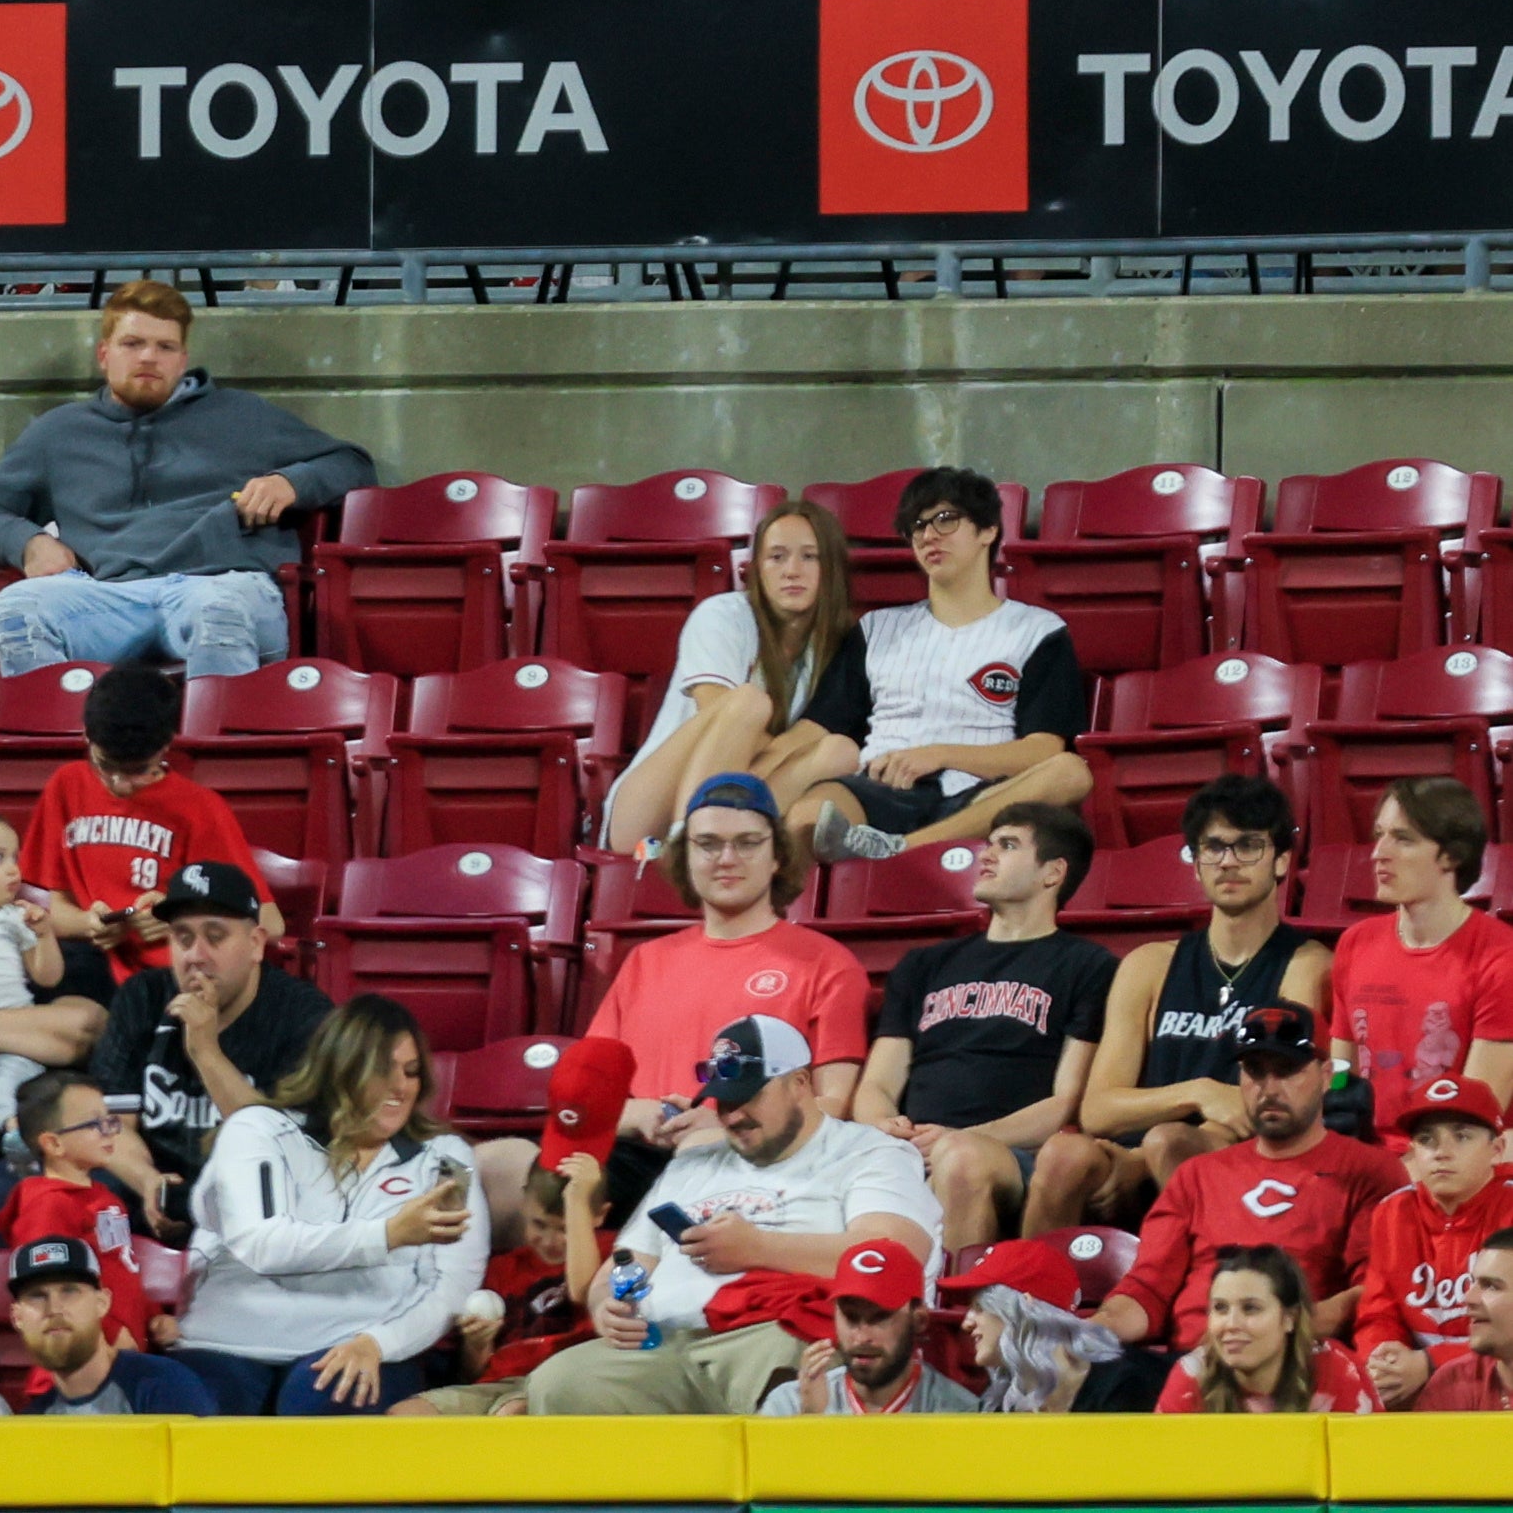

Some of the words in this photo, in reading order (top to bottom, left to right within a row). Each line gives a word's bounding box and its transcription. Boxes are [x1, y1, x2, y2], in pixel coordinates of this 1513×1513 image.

[114, 60, 609, 160] TOYOTA
[130, 856, 159, 889] 19
[920, 980, 1053, 1035] CINCINNATI
